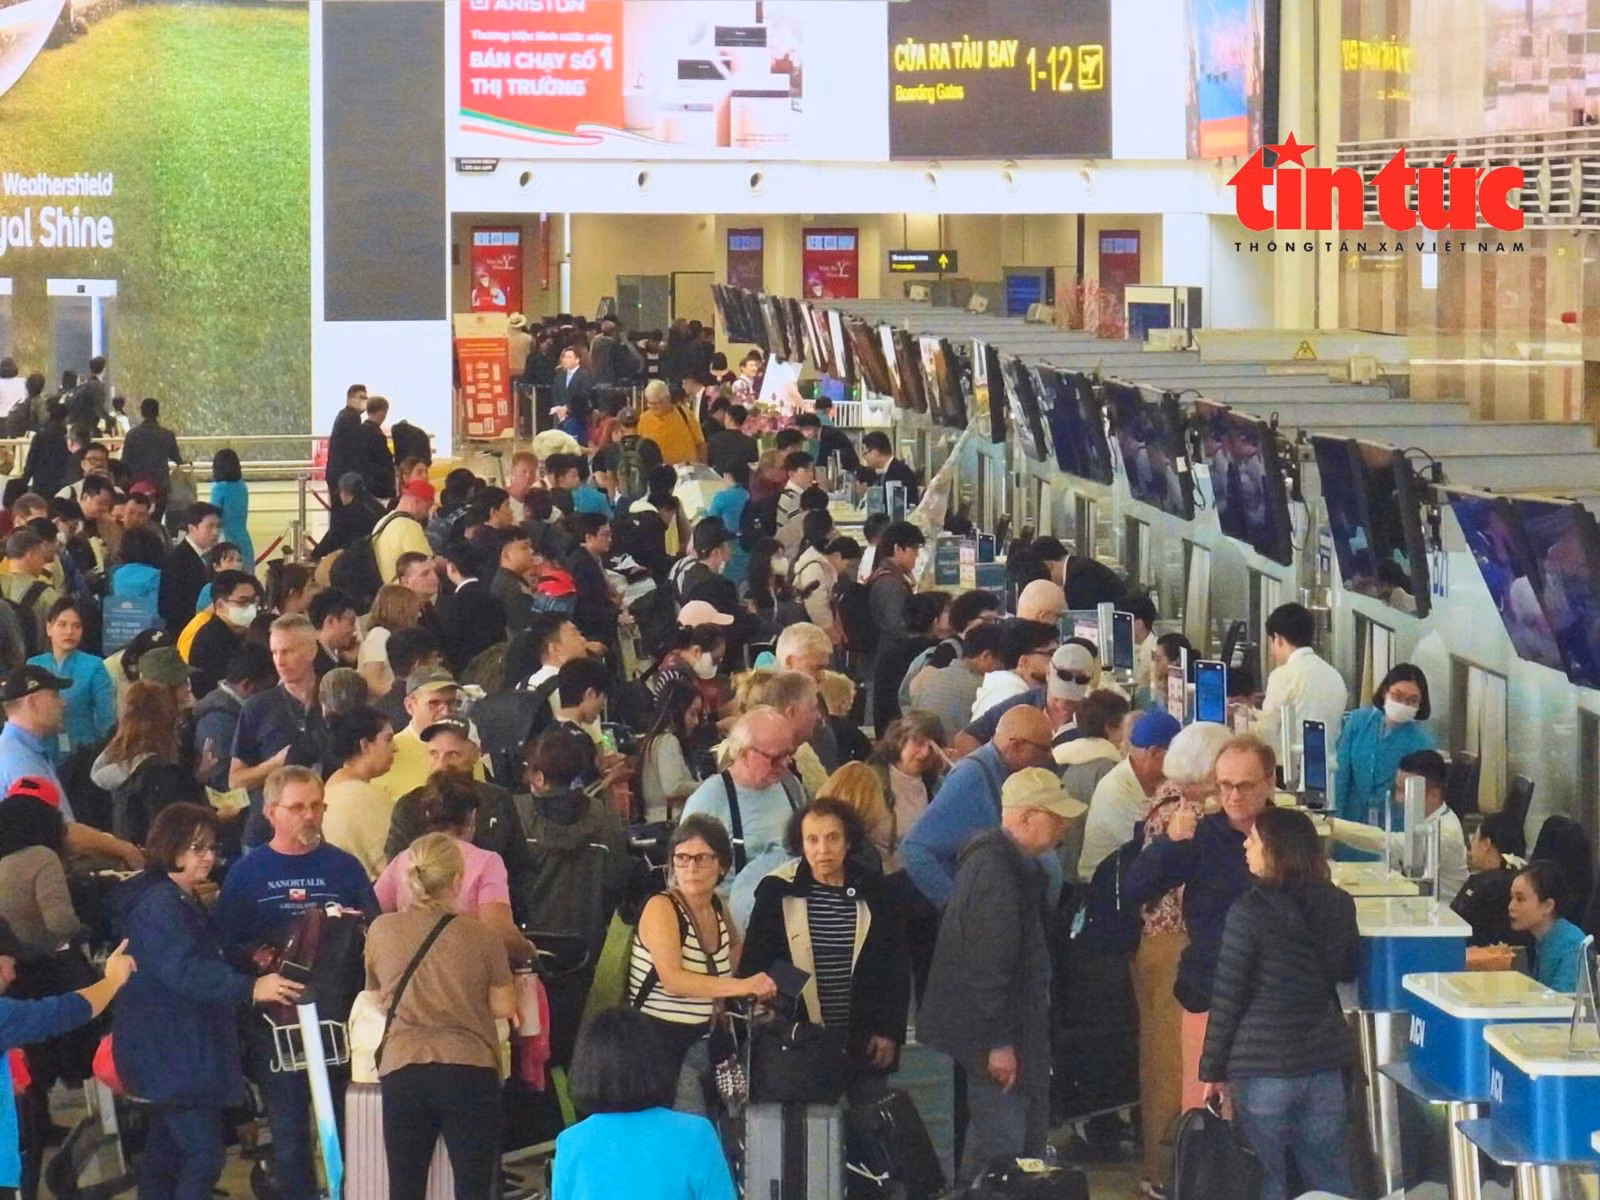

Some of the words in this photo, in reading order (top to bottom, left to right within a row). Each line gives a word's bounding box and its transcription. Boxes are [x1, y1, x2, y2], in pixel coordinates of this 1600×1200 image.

[493, 0, 587, 13] ARISTON
[469, 48, 511, 69] BÁN
[895, 37, 927, 71] CỬA
[928, 43, 951, 69] RA
[952, 34, 984, 69] TÀU
[988, 39, 1019, 68] BAY
[1026, 46, 1073, 92] 1-12
[895, 84, 935, 104] Boarding
[3, 172, 113, 196] Weathershield
[39, 206, 114, 248] Shine
